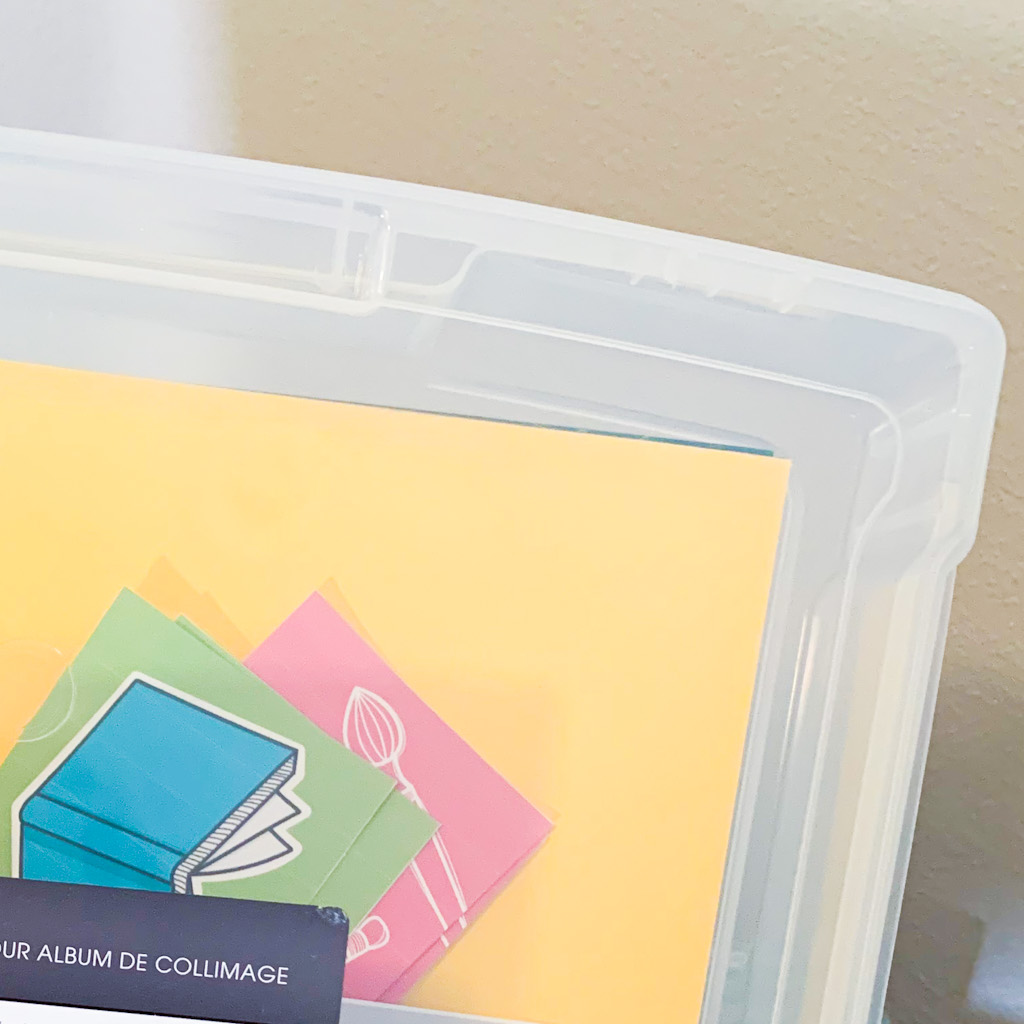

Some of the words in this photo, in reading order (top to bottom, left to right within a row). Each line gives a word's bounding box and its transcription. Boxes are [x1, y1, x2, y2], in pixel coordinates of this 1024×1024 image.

[36, 944, 112, 968] ALBUM
[119, 952, 148, 972] DE
[155, 955, 289, 985] COLLIMAGE
